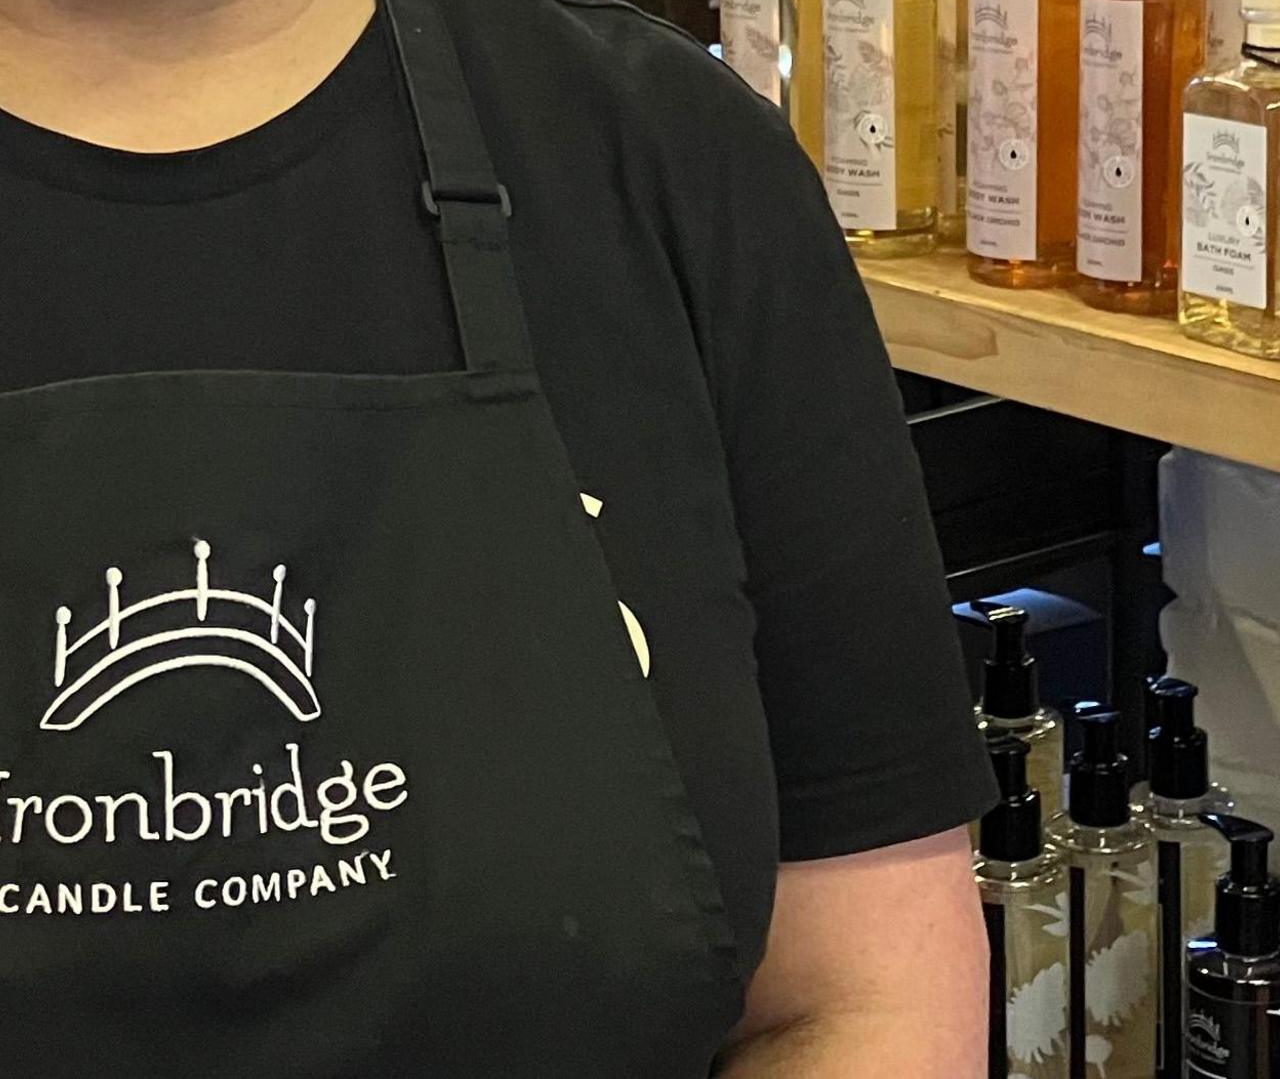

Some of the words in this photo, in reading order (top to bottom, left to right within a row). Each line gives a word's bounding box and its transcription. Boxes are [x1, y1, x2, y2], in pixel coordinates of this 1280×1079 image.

[848, 168, 880, 177] WASH
[1197, 242, 1222, 255] BATH
[1224, 248, 1251, 261] FOAM
[193, 848, 398, 909] COMPANY
